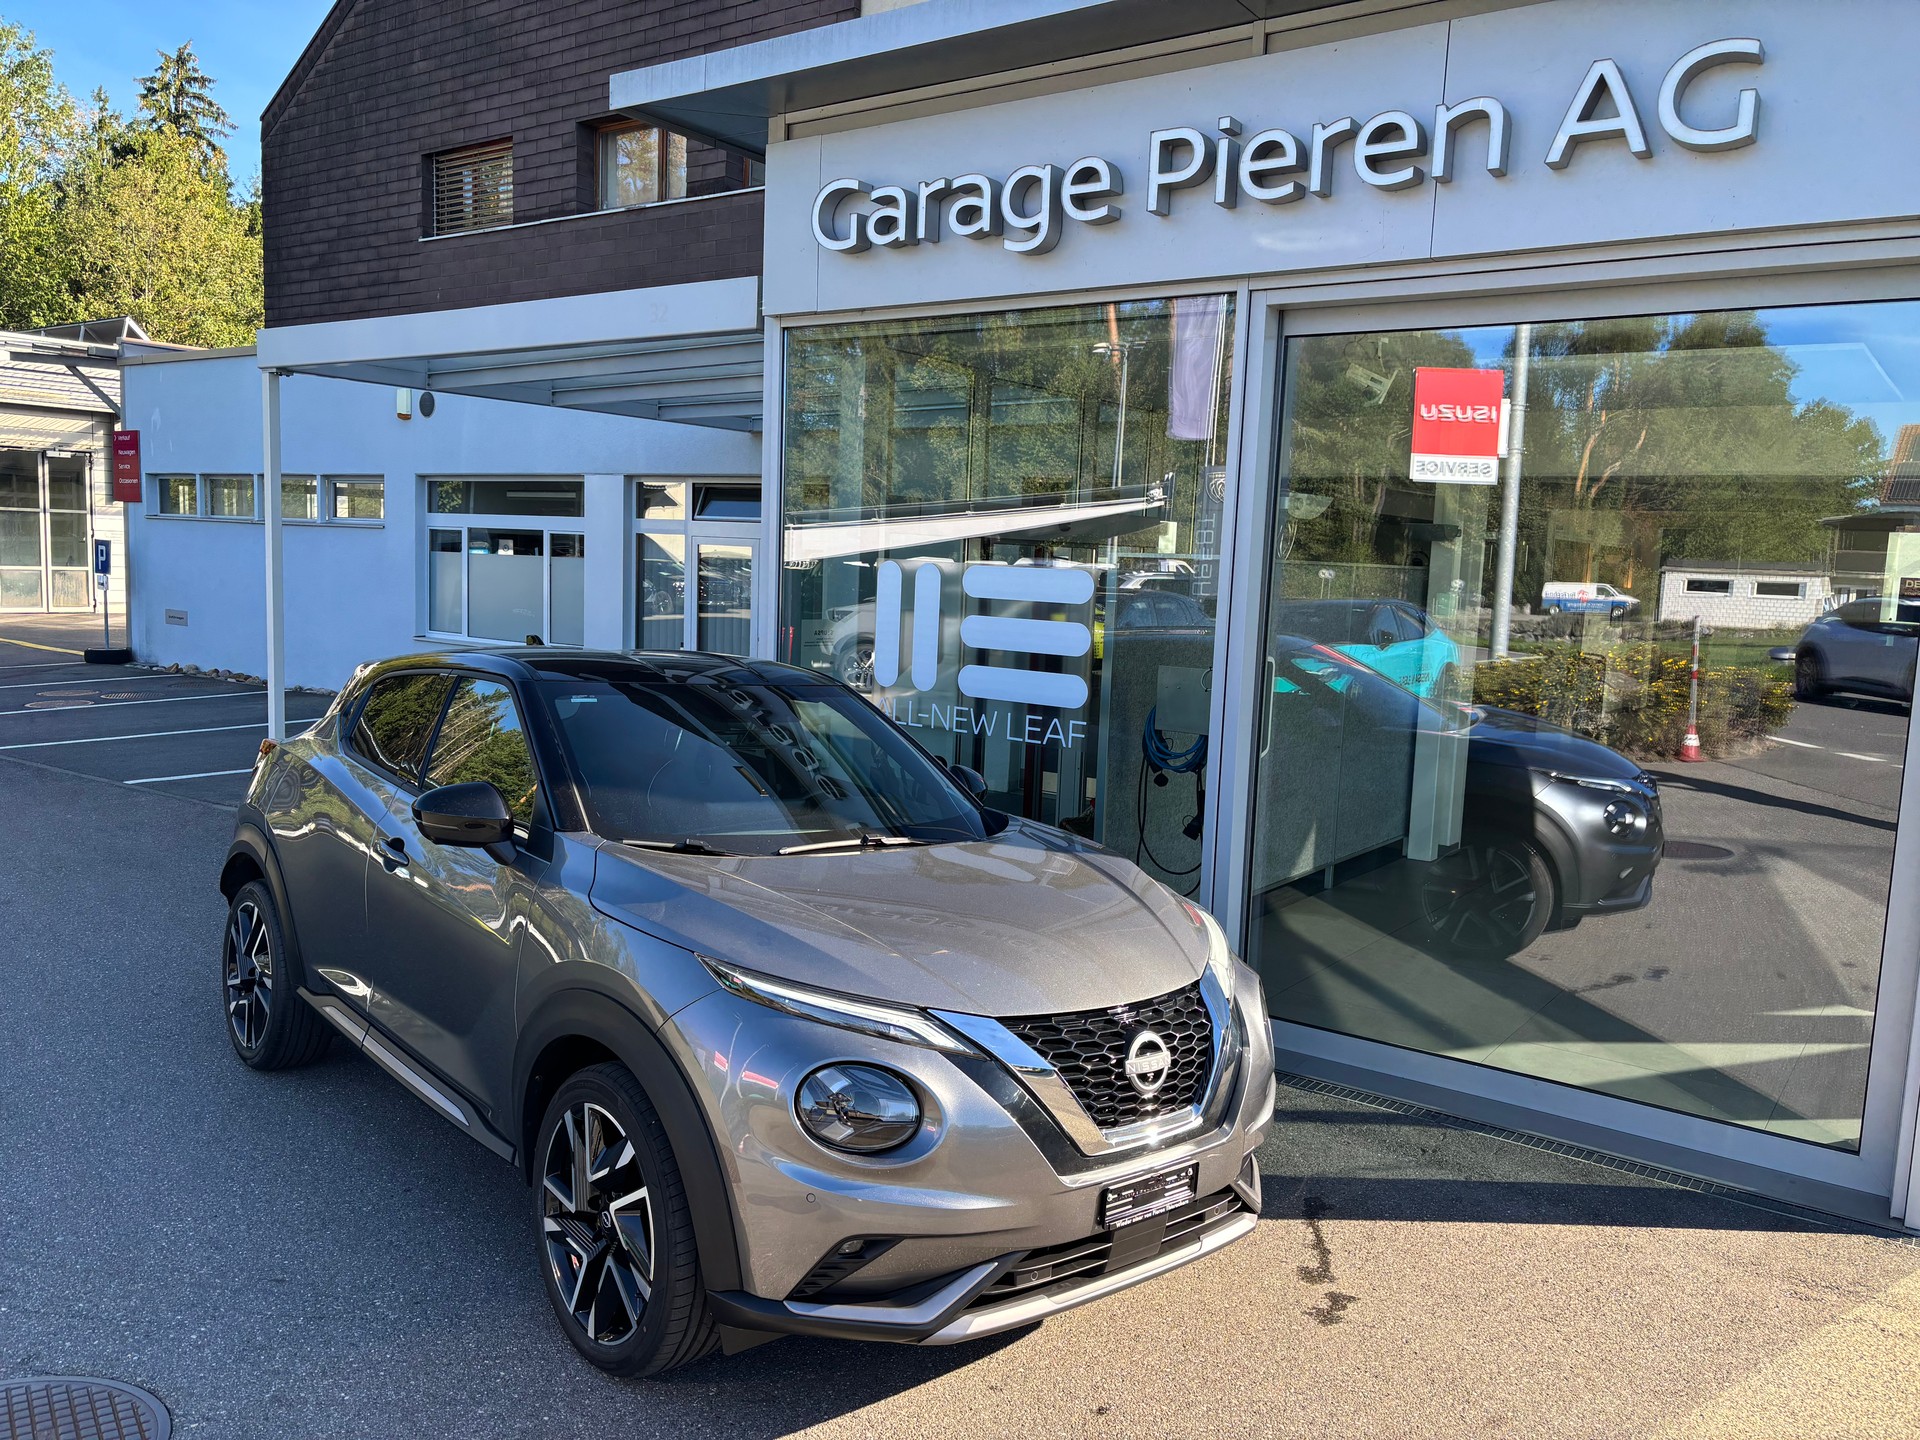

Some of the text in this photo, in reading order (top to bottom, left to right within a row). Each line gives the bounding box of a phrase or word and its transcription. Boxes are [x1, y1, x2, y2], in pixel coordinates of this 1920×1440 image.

[811, 37, 1765, 256] Garage Pieren AG
[98, 545, 106, 570] P
[876, 697, 1088, 748] ALL-NEW LEAF
[1126, 1054, 1170, 1074] NISSAN
